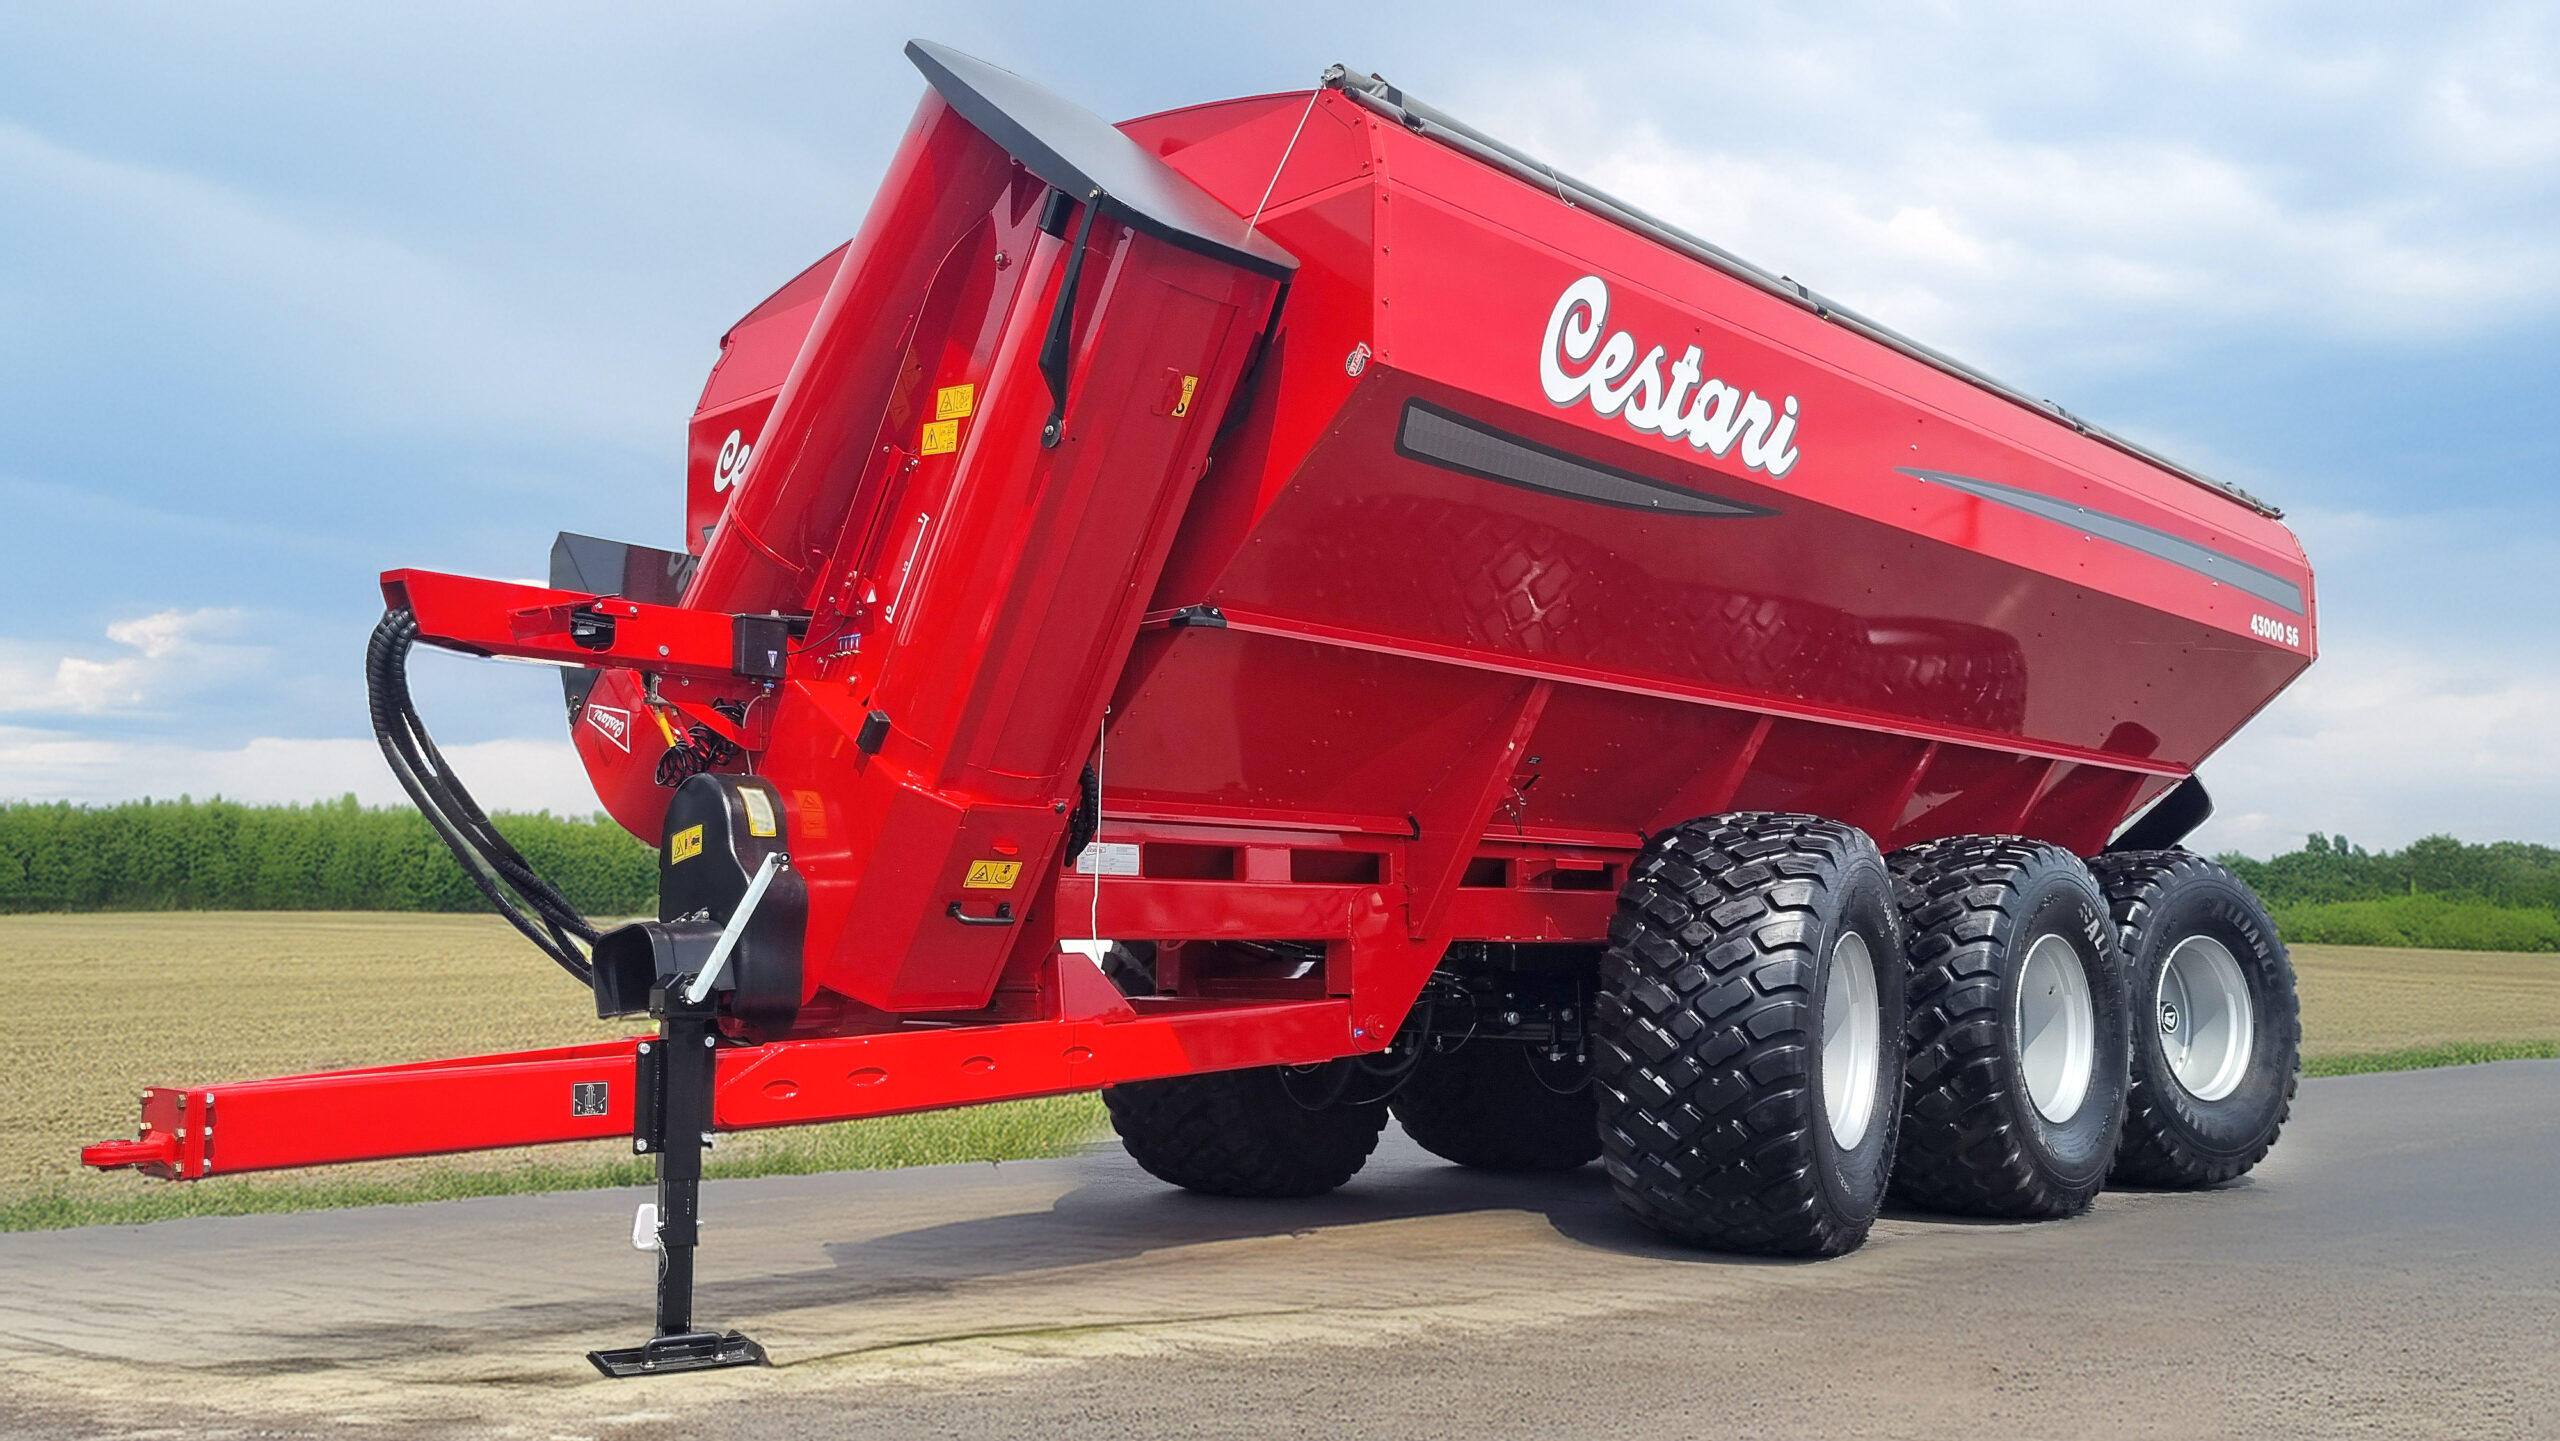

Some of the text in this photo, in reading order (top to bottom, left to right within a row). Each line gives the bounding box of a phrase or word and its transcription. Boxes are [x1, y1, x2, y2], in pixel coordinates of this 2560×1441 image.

[1540, 275, 1799, 478] Cestari
[2250, 613, 2299, 647] 43000 S6
[593, 709, 625, 739] Cestari
